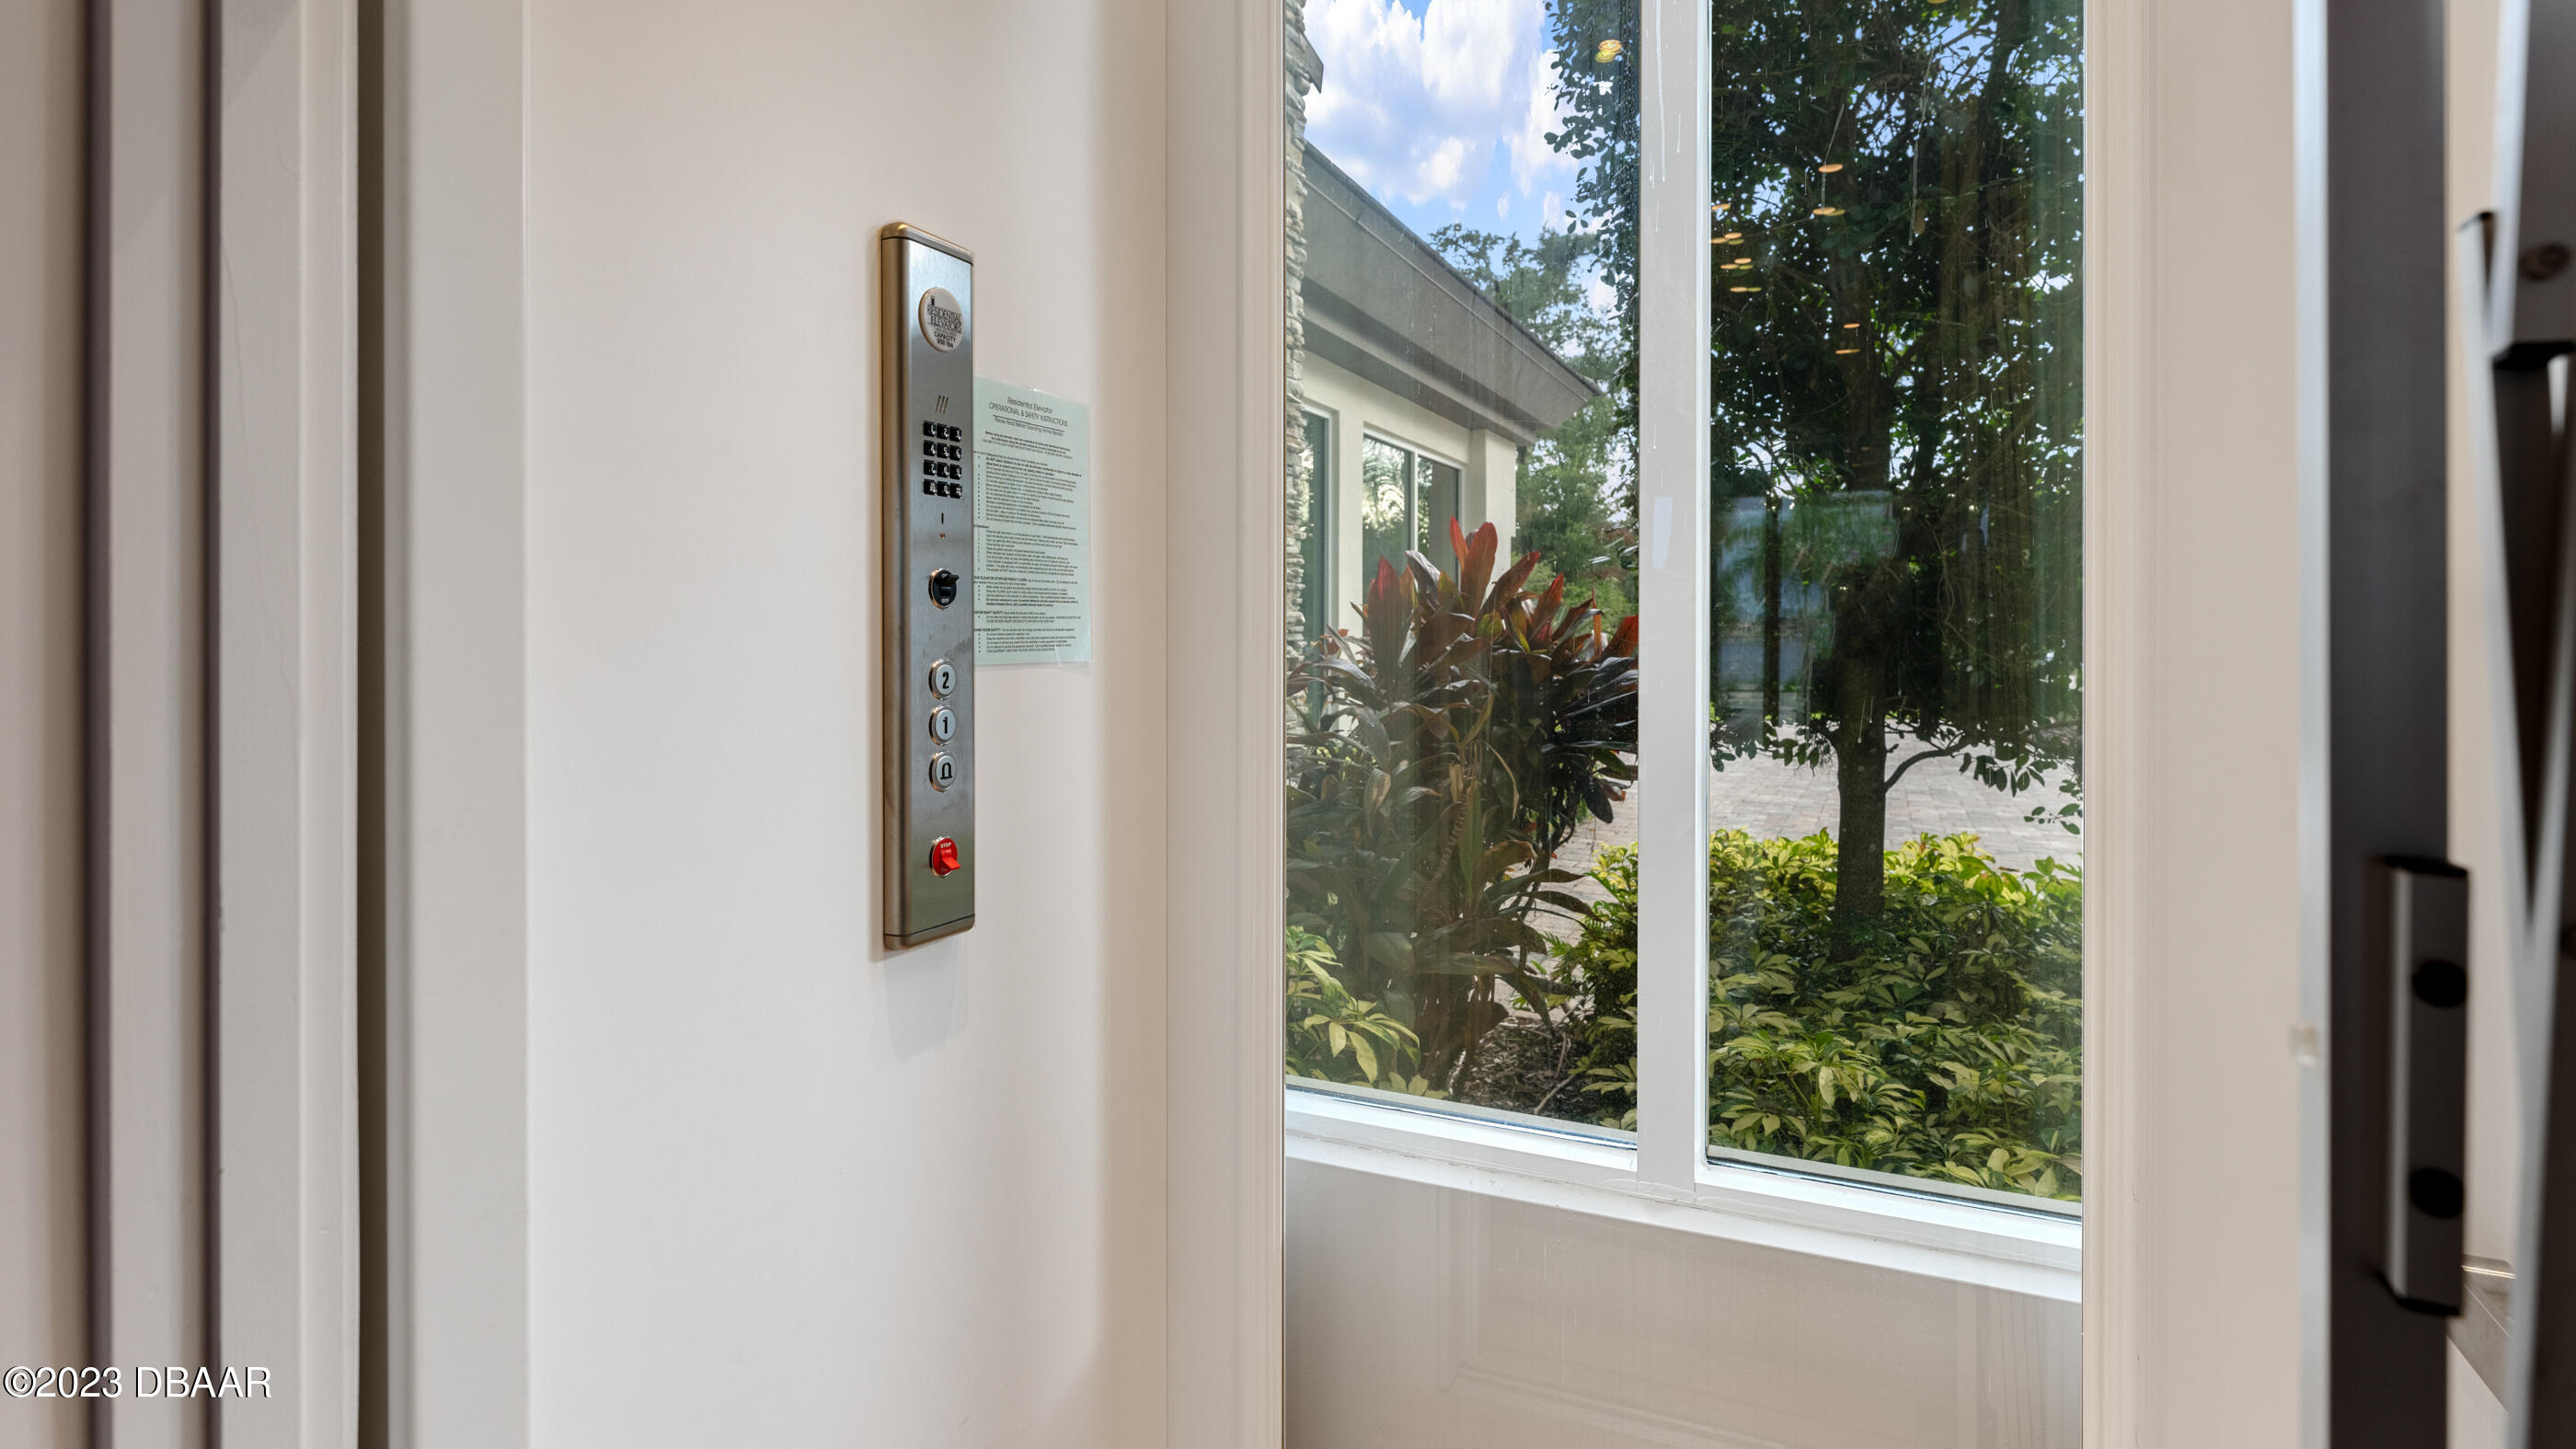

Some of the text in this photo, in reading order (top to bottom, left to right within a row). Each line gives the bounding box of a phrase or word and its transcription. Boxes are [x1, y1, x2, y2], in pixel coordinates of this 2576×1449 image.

[927, 305, 962, 323] RESIDENTIAL
[930, 315, 962, 333] ELEVATORS
[934, 331, 956, 342] CAPACITY
[1007, 397, 1053, 414] Residential Elevator
[989, 402, 1019, 416] OPERATIONAL
[1025, 410, 1040, 420] SAFETY
[1040, 414, 1068, 428] INSTRUCTIONS
[942, 671, 949, 689] 2
[942, 716, 949, 734] 1
